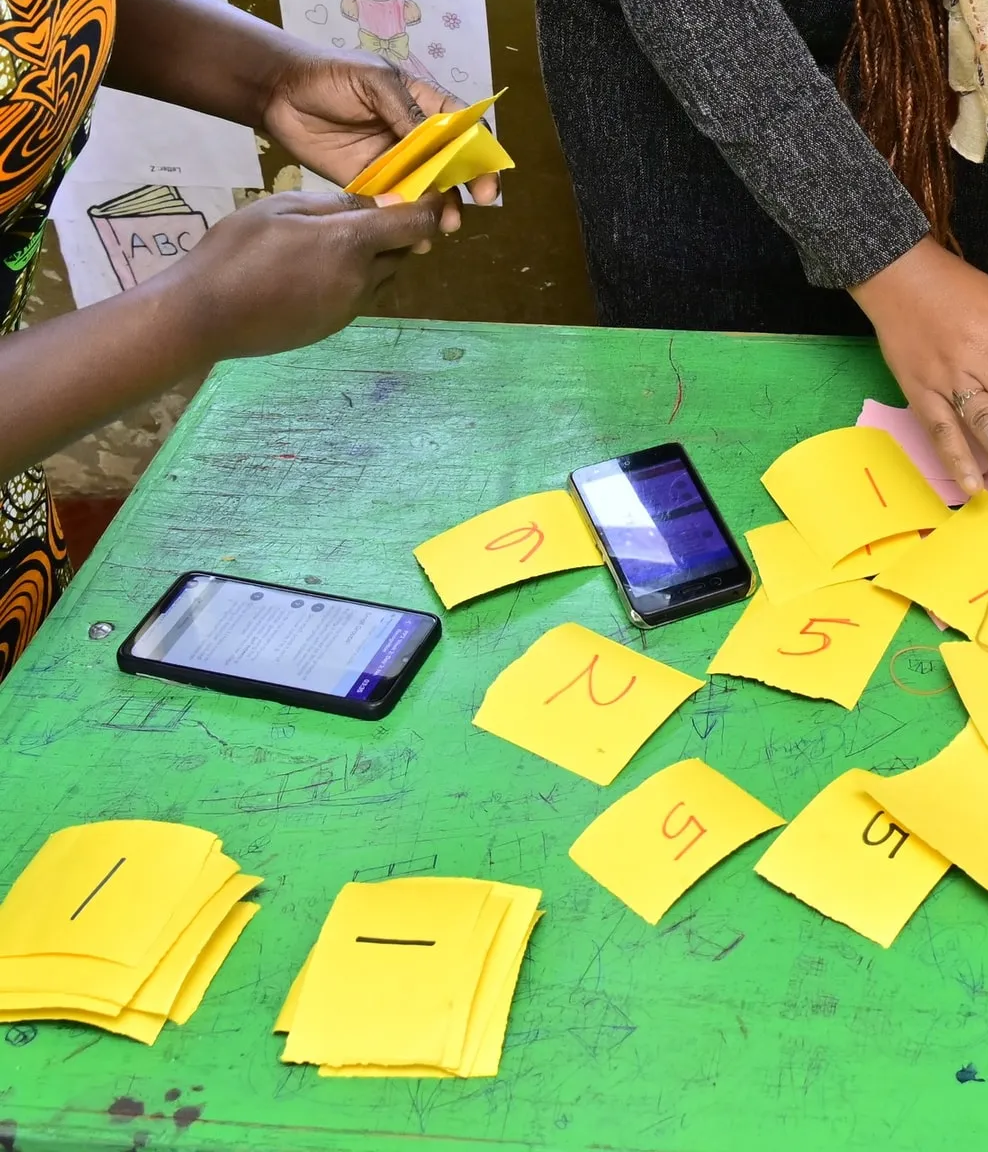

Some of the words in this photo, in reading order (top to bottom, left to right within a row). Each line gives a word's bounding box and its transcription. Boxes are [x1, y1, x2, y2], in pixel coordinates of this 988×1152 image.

[131, 231, 191, 259] ABC
[778, 616, 860, 656] 5
[862, 810, 910, 859] 5
